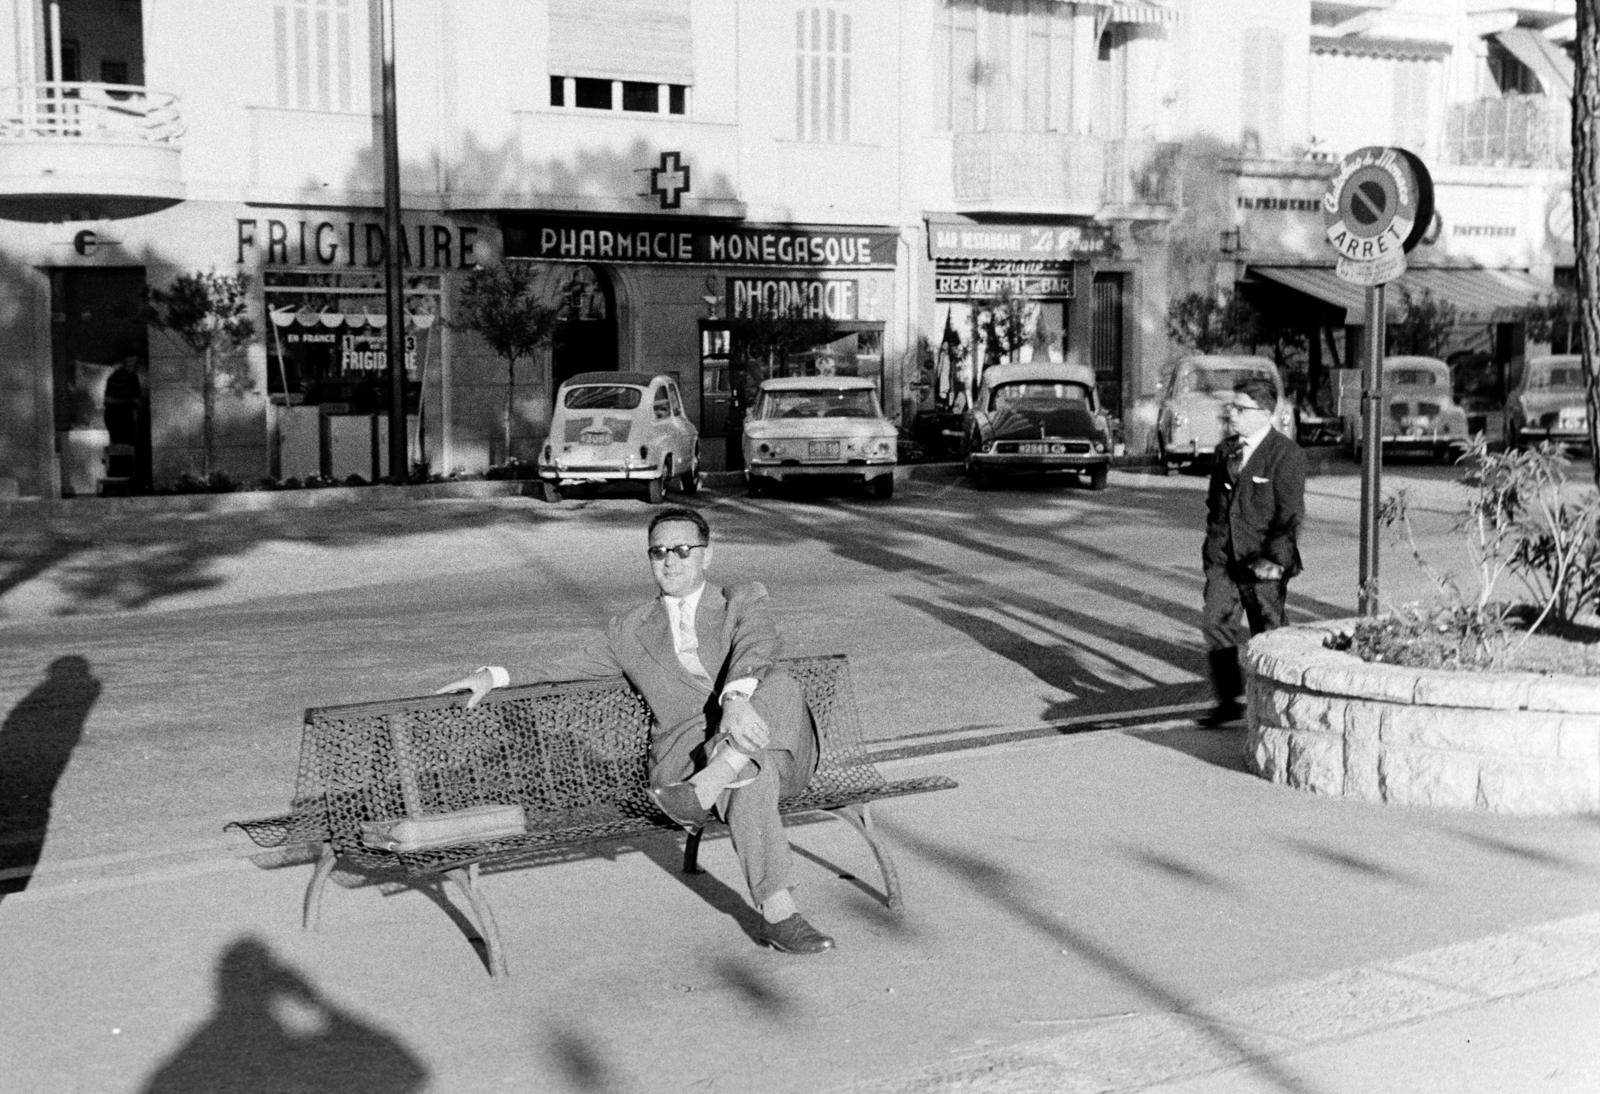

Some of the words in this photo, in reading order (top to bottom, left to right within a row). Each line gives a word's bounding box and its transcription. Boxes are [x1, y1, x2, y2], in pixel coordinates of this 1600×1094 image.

[1374, 147, 1408, 207] Monaco
[1237, 197, 1321, 212] IMPRIMERIE
[1453, 224, 1517, 237] PAPETERIE
[541, 227, 693, 259] PHARMACIE
[709, 233, 872, 266] MONÉGASQUE
[937, 232, 959, 249] BAR
[962, 233, 1021, 252] RESTAURANT
[1333, 224, 1400, 257] ARRET
[1041, 278, 1069, 292] BAR
[287, 334, 300, 343] EN
[302, 334, 336, 343] FRANCE
